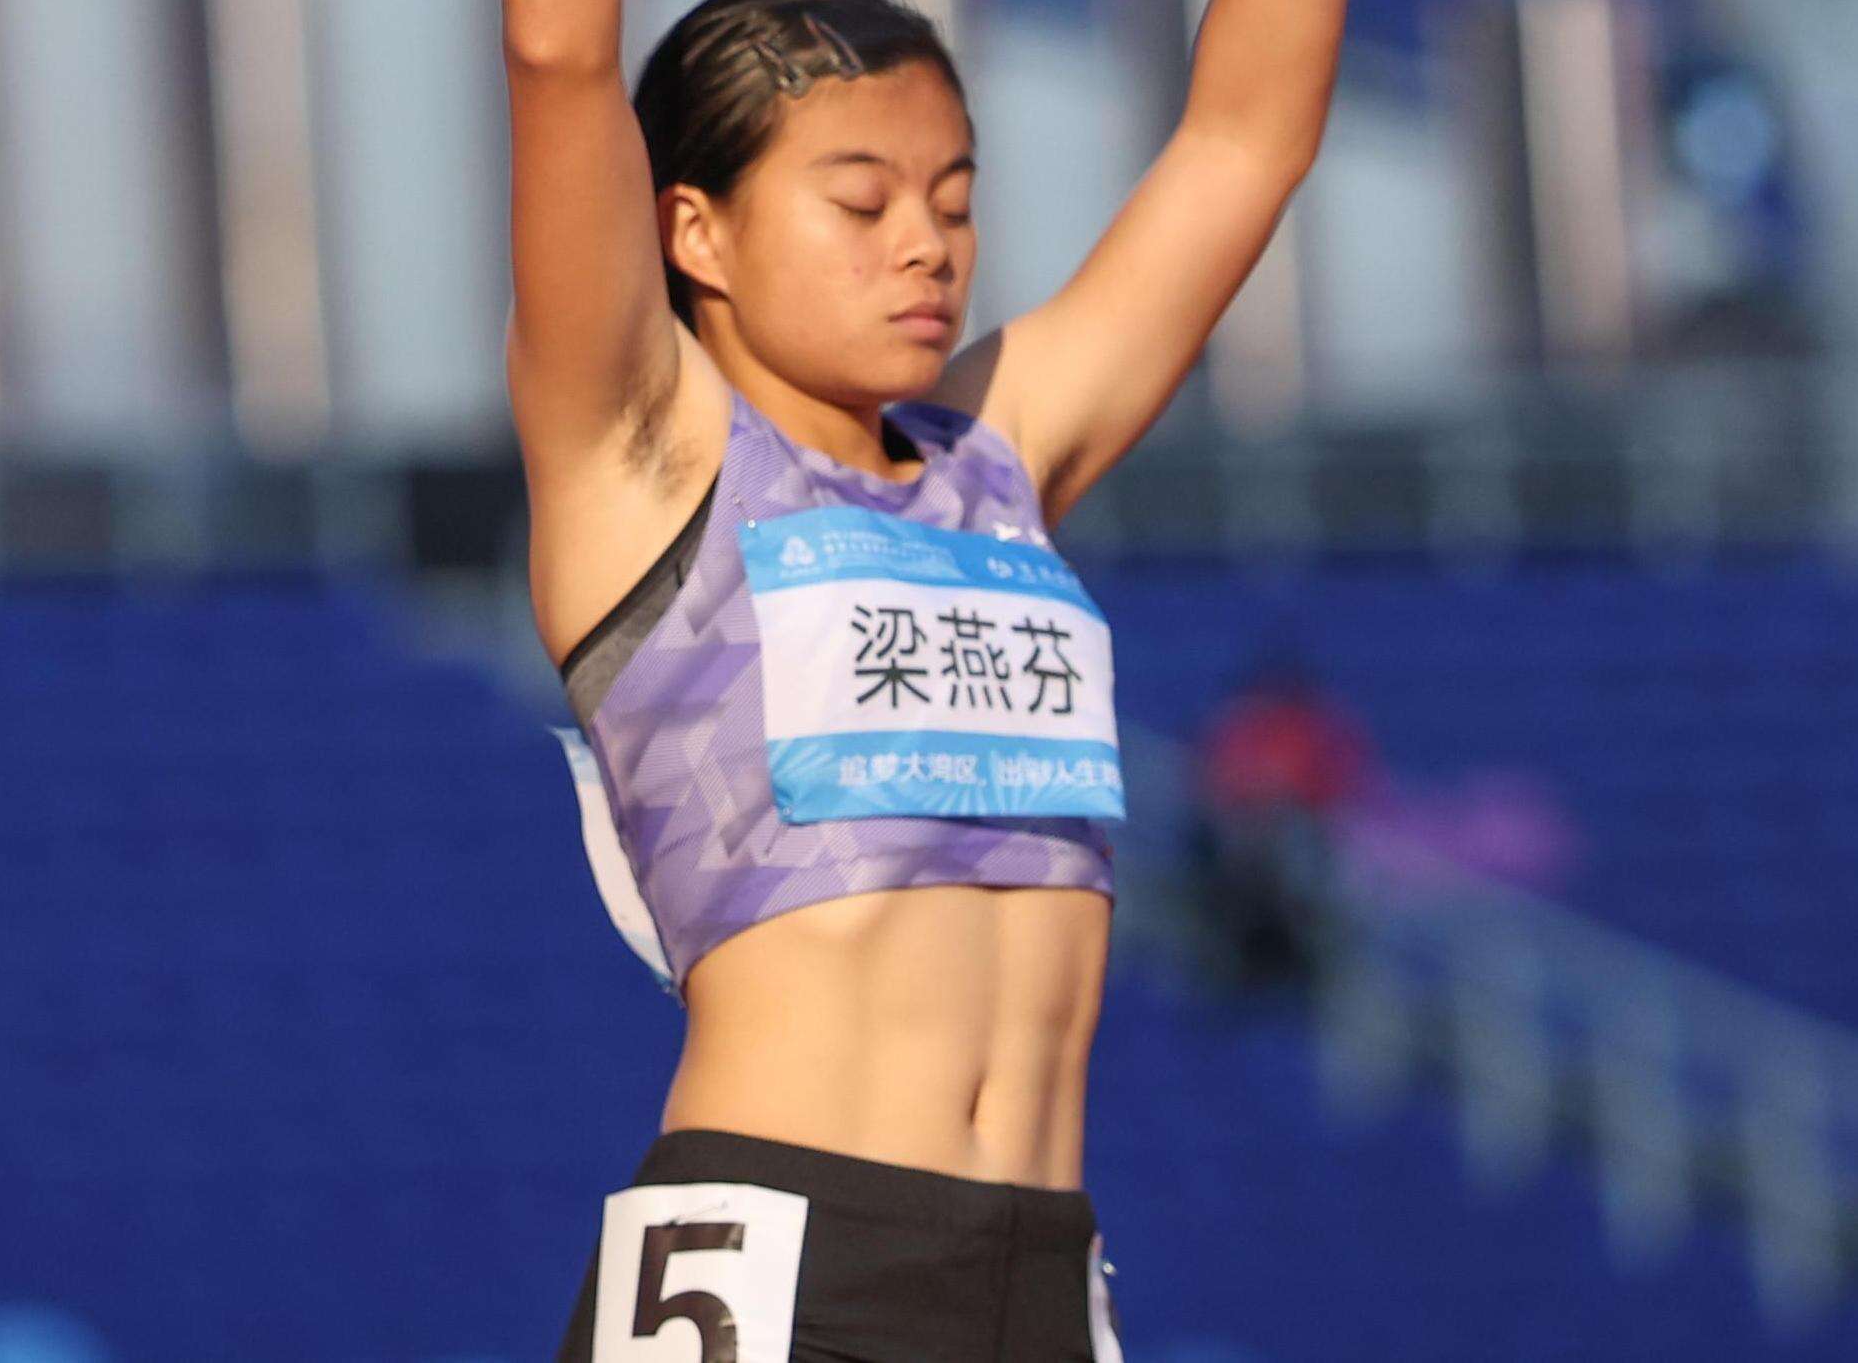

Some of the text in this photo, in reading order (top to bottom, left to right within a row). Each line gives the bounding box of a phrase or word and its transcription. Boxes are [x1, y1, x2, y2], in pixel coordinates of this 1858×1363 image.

[850, 604, 1082, 715] 梁燕芬
[632, 1221, 746, 1363] 5
